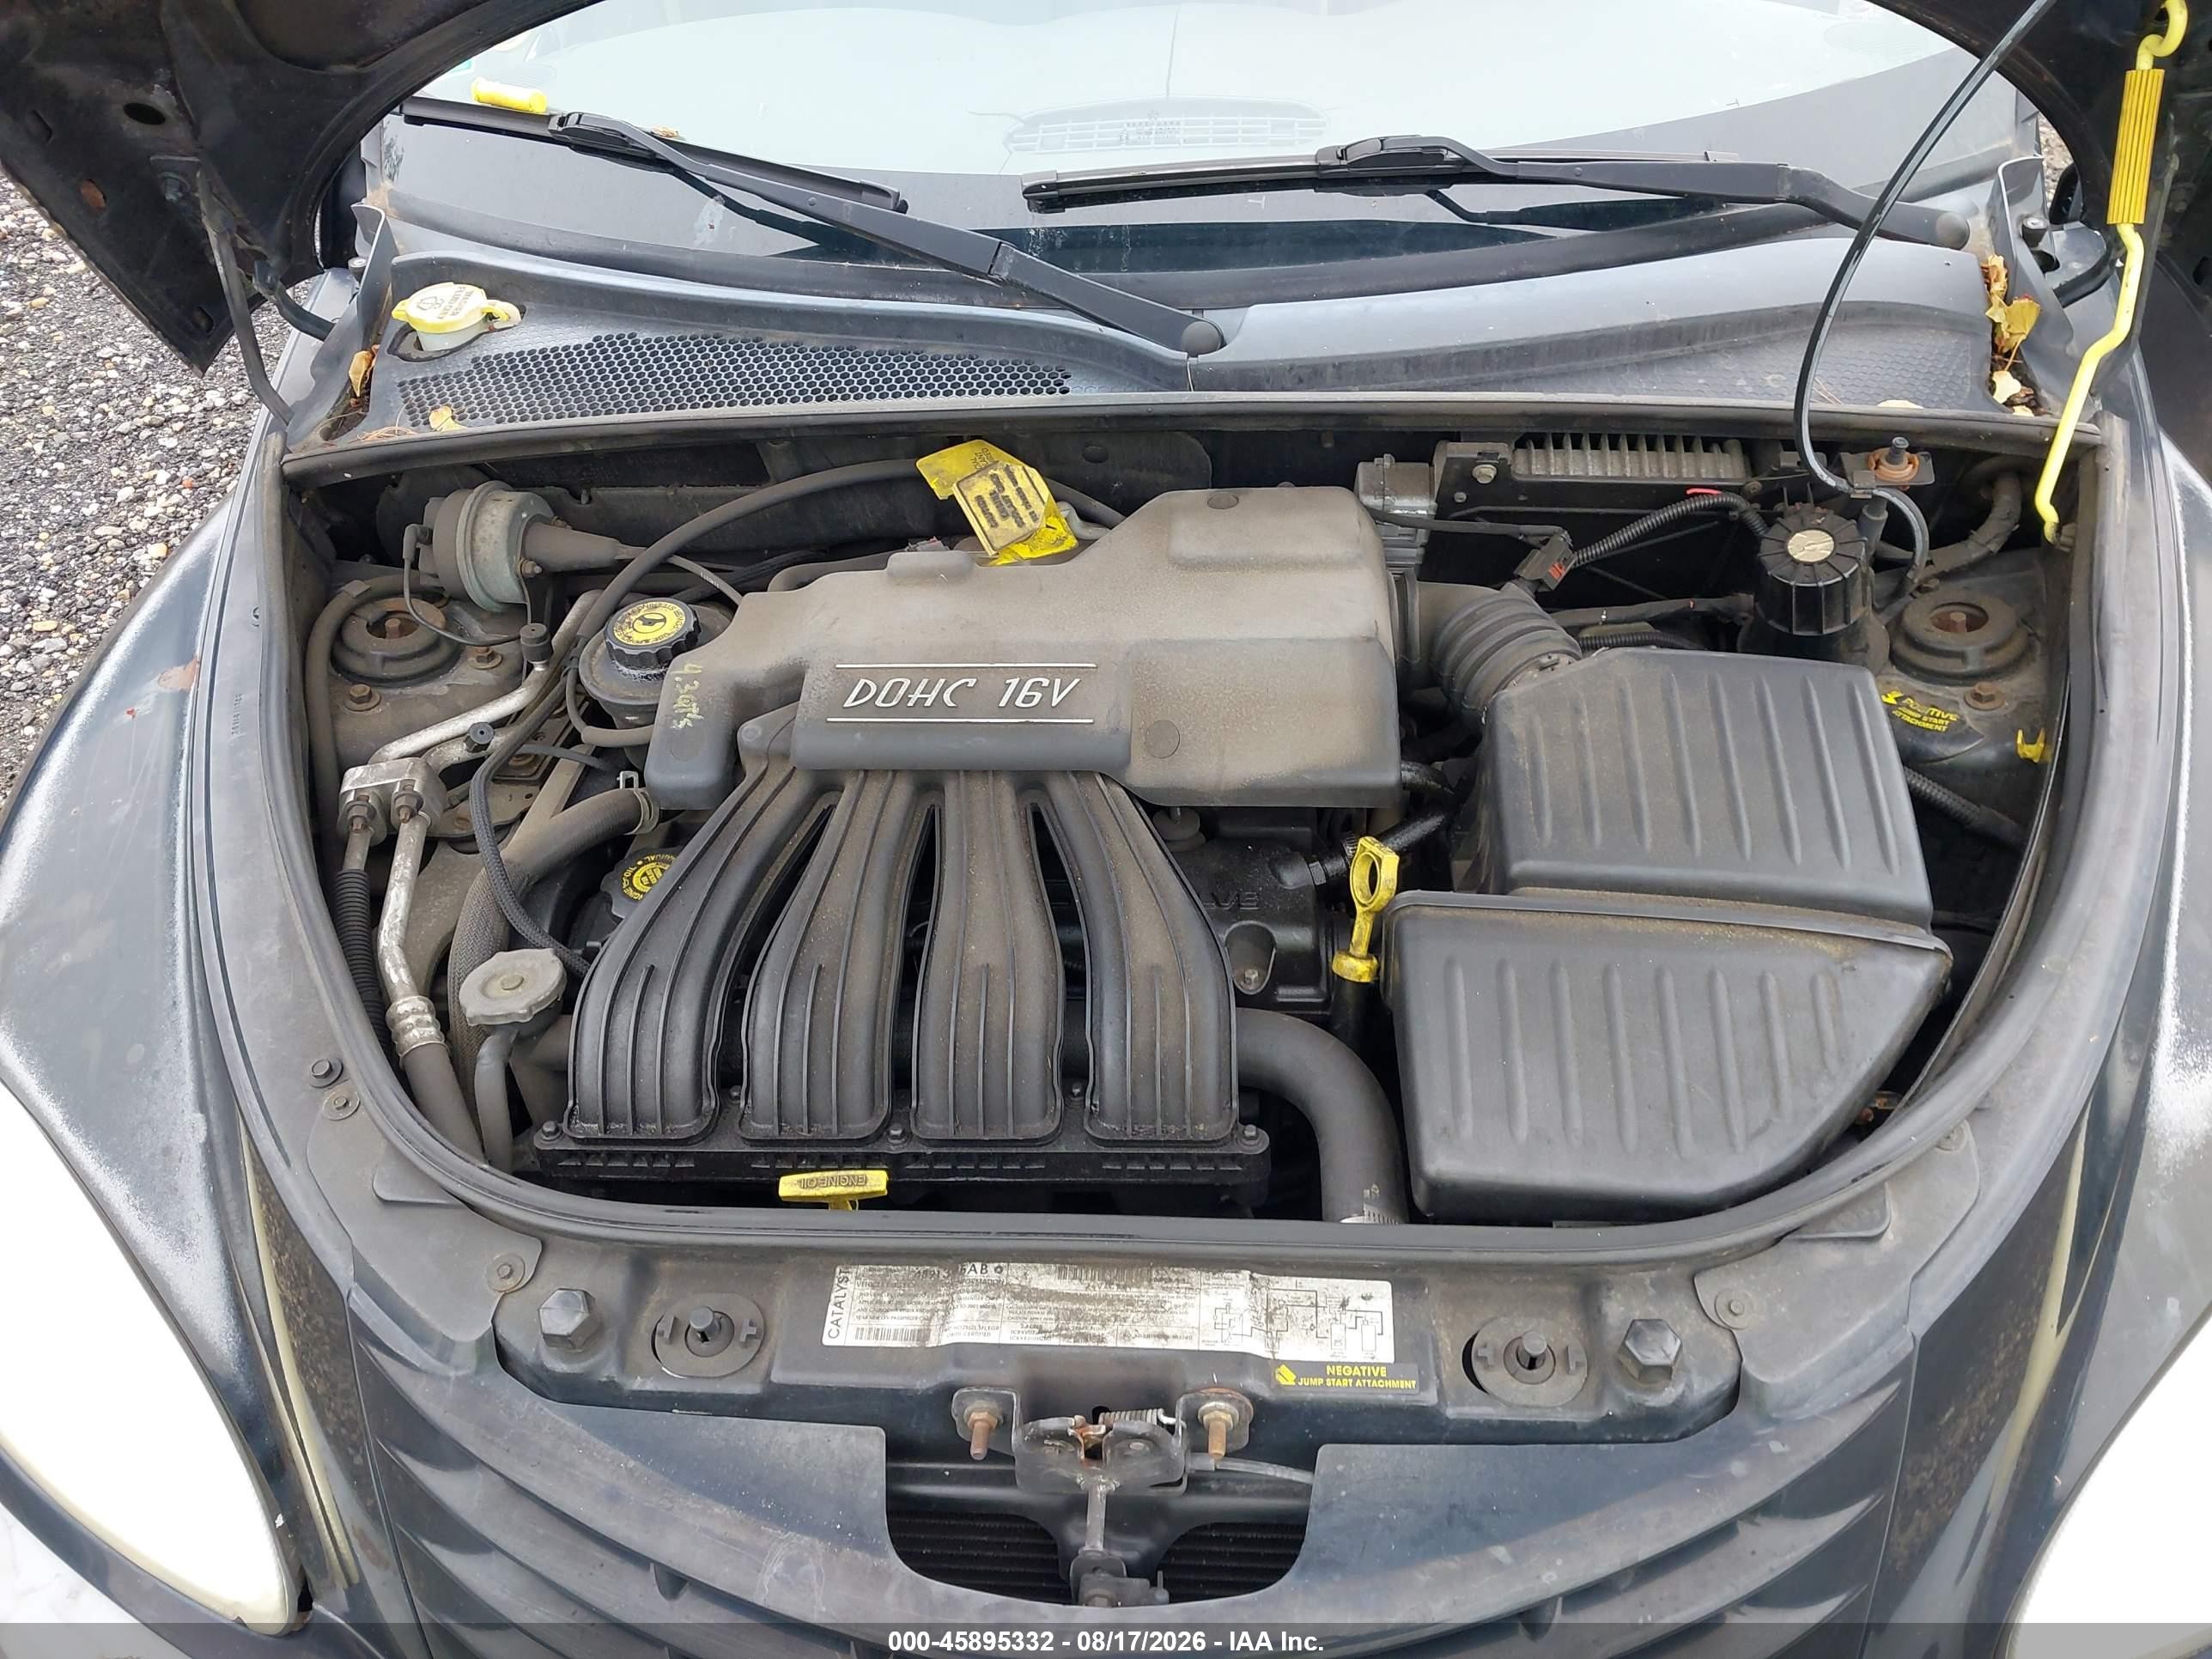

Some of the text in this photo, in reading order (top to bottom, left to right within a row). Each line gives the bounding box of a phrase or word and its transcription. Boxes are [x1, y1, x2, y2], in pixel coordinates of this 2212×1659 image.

[842, 678, 1082, 708] DOHC 16V
[1892, 710, 1948, 732] ATTACHMENT
[1921, 715, 1952, 726] START
[623, 866, 637, 879] OIL
[797, 1174, 867, 1188] ENGINE OIL
[828, 1269, 851, 1339] CATALYST
[1326, 1365, 1387, 1377] NEGATIVE
[1297, 1377, 1416, 1389] JUMP START ATTACHMENT
